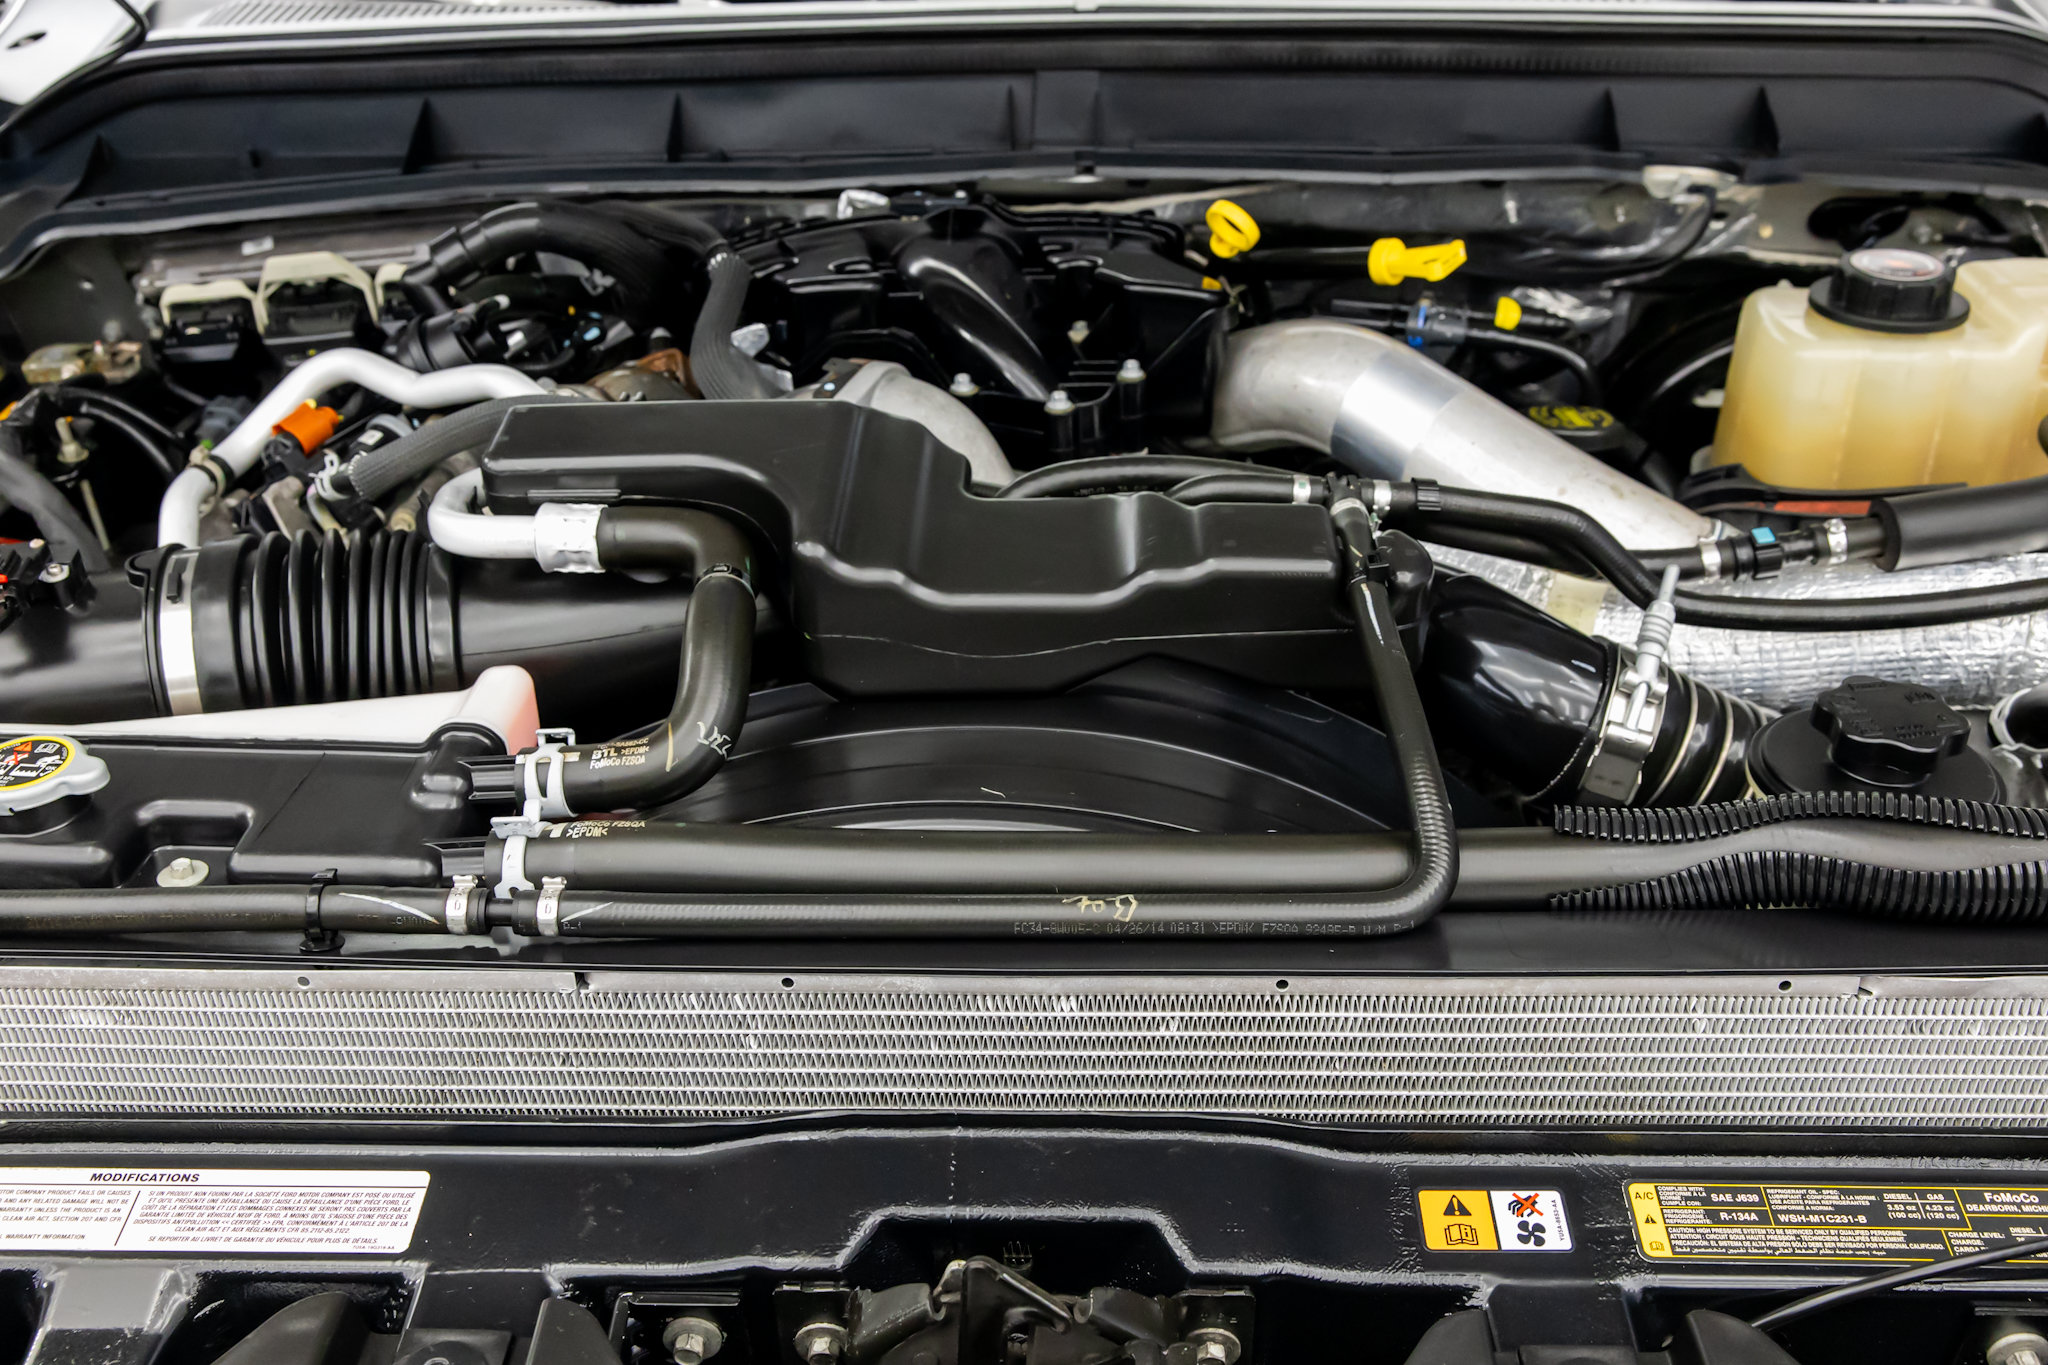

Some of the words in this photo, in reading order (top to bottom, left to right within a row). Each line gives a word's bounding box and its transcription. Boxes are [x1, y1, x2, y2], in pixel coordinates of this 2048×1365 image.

[592, 748, 618, 759] BTL
[590, 757, 620, 769] FoMoCo
[566, 827, 608, 838] >EPDM<
[1107, 922, 1164, 934] 04/26/14
[1170, 922, 1205, 934] 08:31
[90, 1173, 200, 1182] MODIFICATIONS
[1635, 1192, 1654, 1200] A/C
[1710, 1194, 1733, 1202] SAE
[1735, 1194, 1759, 1202] J639
[1984, 1192, 2039, 1203] FoMoCo
[1966, 1204, 2021, 1213] DEARBORN,
[1720, 1212, 1759, 1221] R-134A
[1777, 1214, 1867, 1224] WSH-M1C231-B
